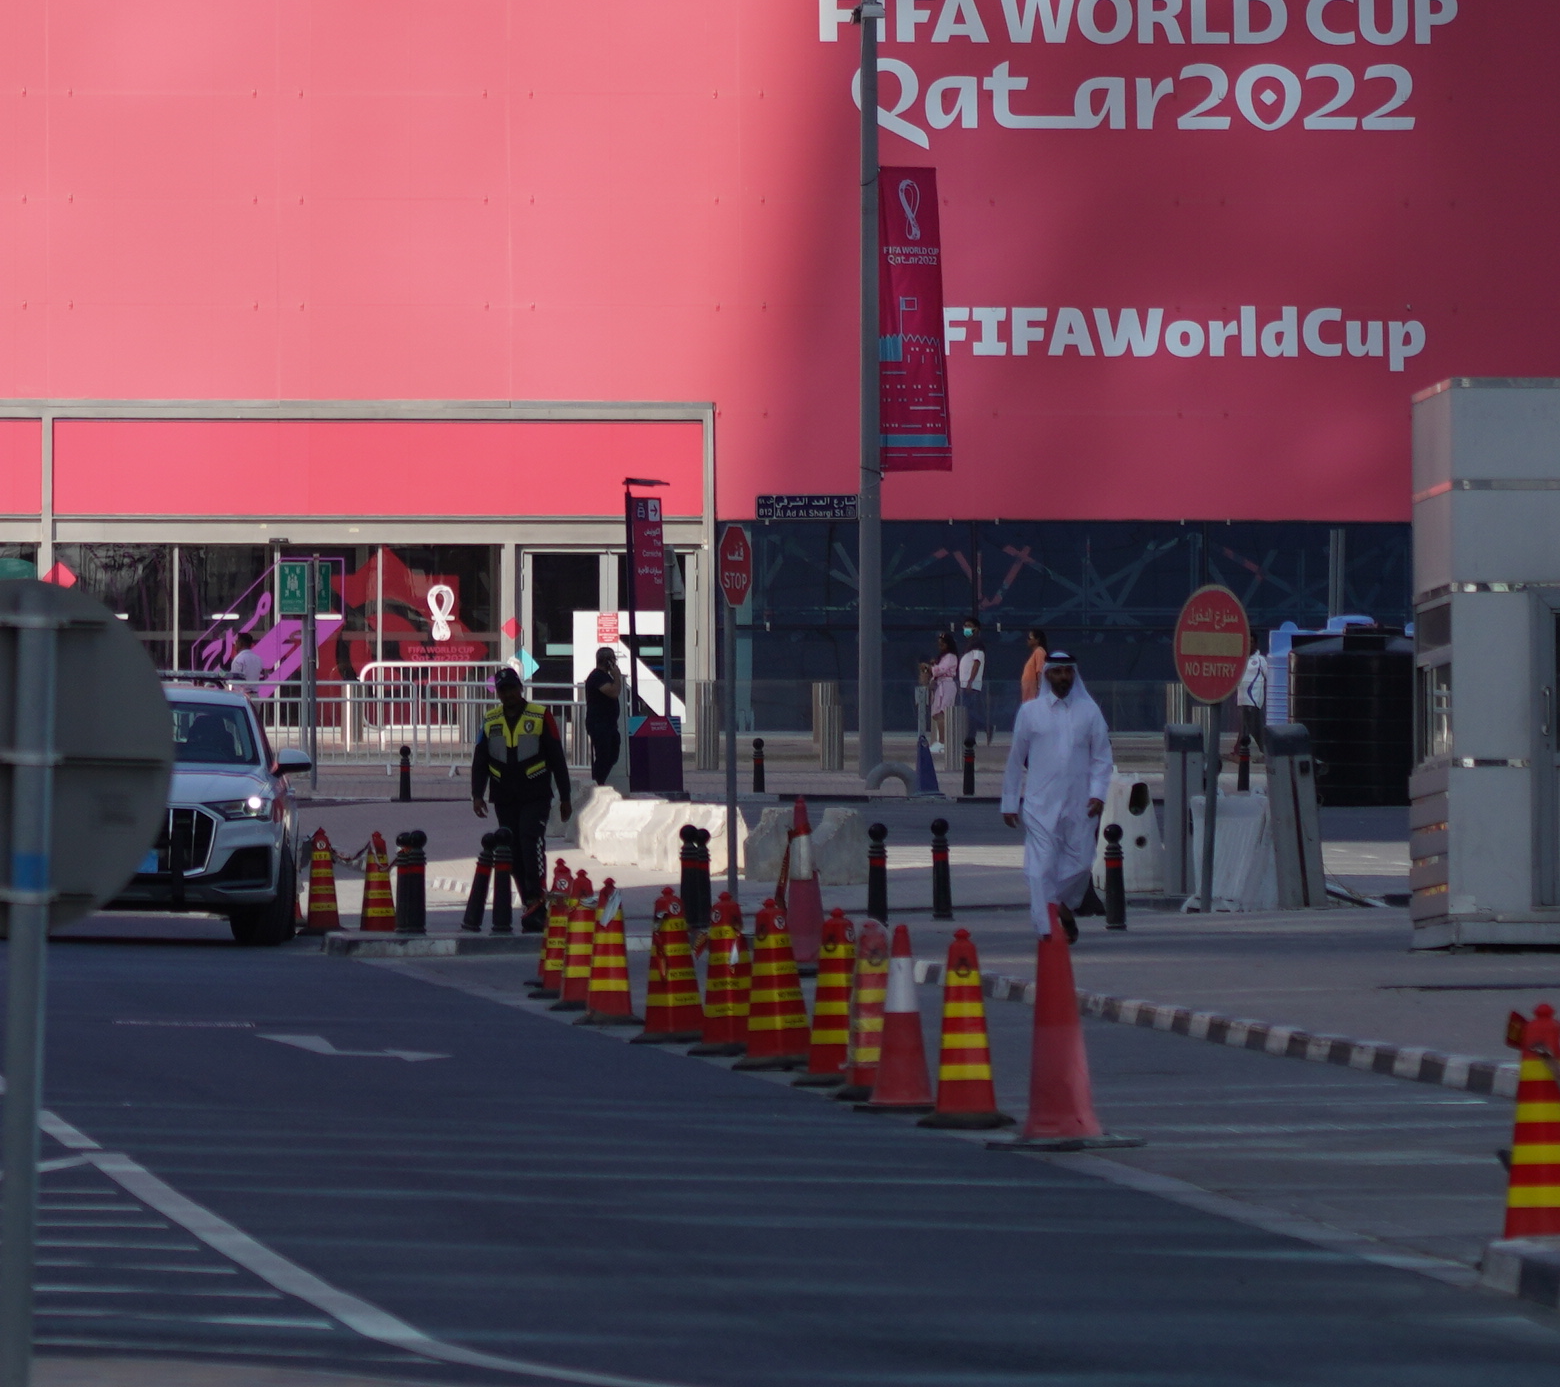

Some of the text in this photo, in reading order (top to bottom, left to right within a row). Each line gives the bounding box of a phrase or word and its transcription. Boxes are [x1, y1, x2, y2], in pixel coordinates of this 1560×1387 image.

[883, 246, 901, 254] FIFA
[901, 247, 927, 255] WORLD
[723, 572, 748, 590] STOP
[1185, 662, 1237, 678] NO ENTRY
